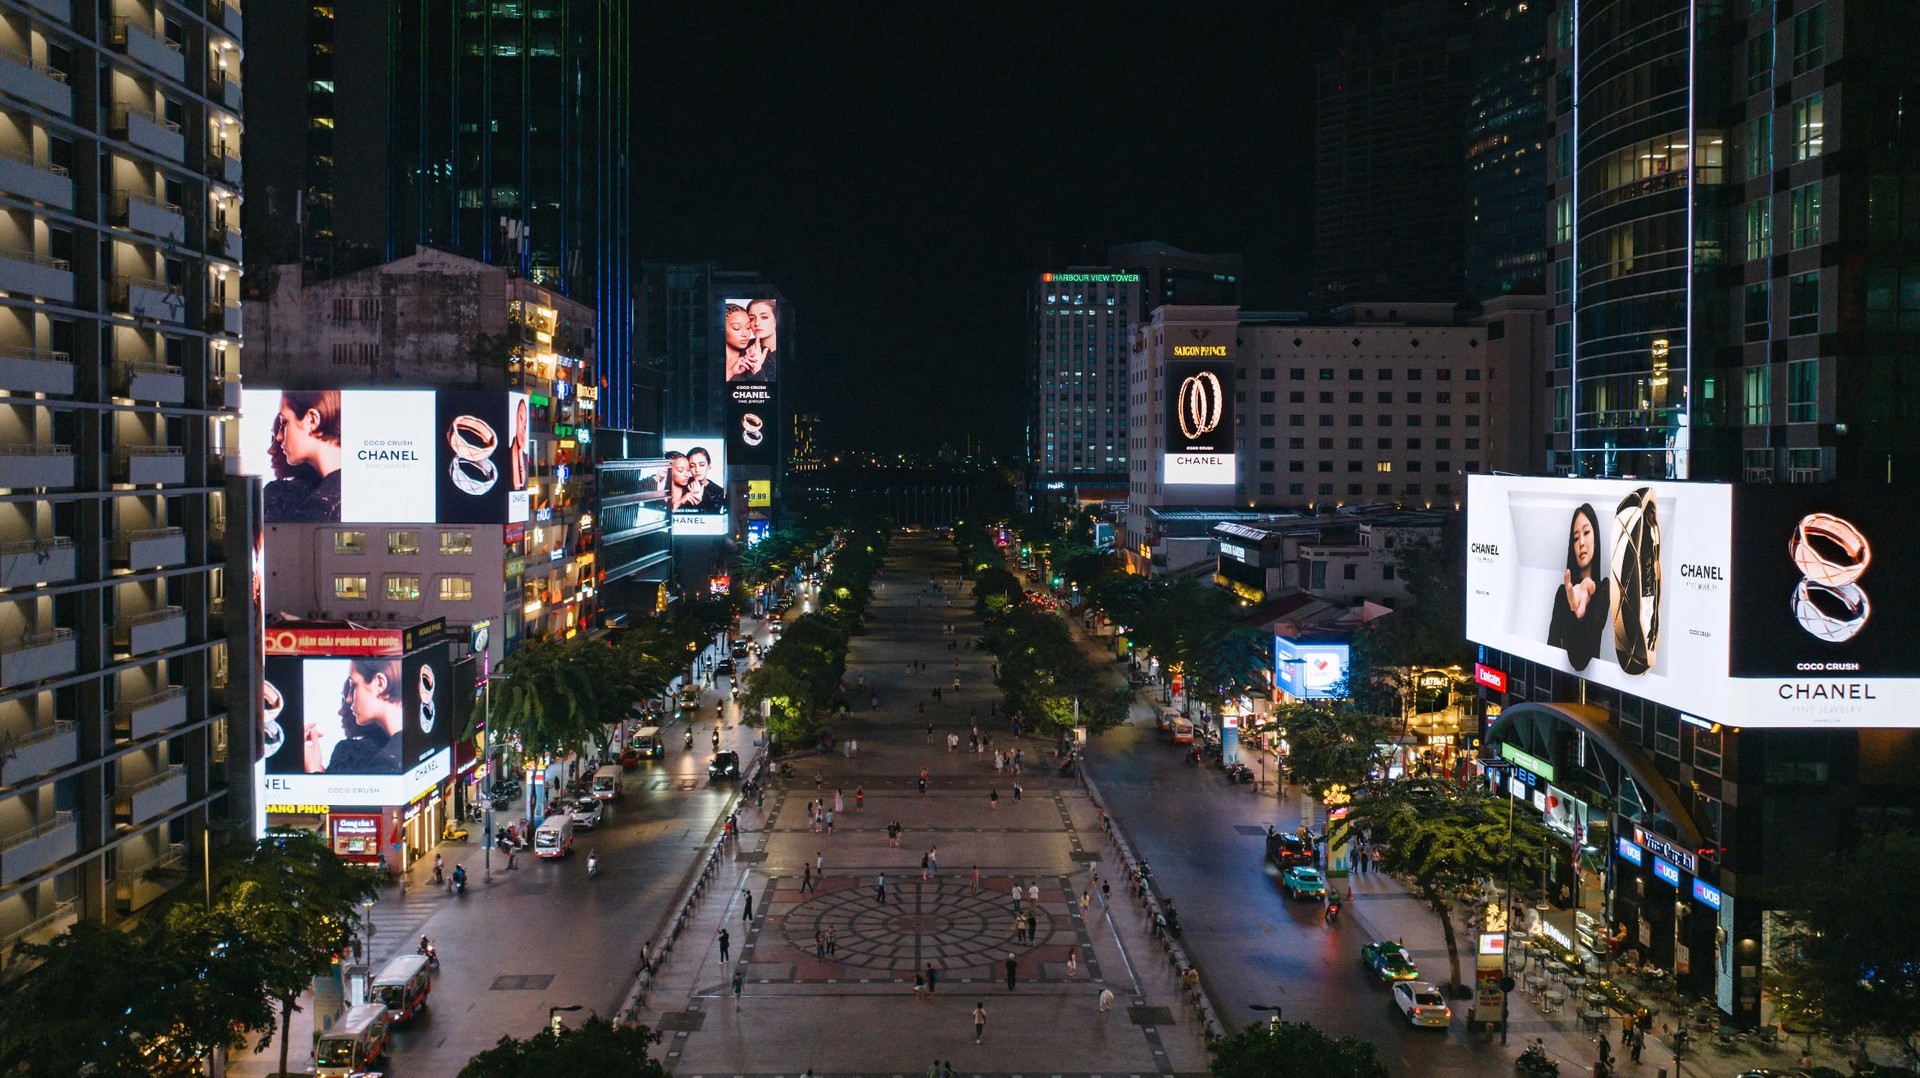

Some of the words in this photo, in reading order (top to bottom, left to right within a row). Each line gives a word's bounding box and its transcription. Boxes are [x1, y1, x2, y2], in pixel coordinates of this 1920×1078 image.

[1052, 274, 1088, 282] HARBOUR
[1090, 274, 1109, 282] VIEW
[1111, 274, 1138, 282] TOWER
[1174, 346, 1200, 356] SAIGON
[1200, 346, 1226, 356] PRINCE
[732, 391, 770, 399] CHANEL
[357, 450, 419, 461] CHANEL
[1176, 456, 1223, 465] CHANEL
[1471, 542, 1499, 556] CHANEL
[1680, 563, 1724, 581] CHANEL
[1480, 668, 1500, 687] Emirates
[1778, 684, 1876, 699] CHANEL
[415, 760, 438, 781] CHANEL
[297, 804, 330, 814] PHUC
[1627, 845, 1641, 861] UOB
[1663, 865, 1678, 882] UOB
[1703, 887, 1720, 906] UOB
